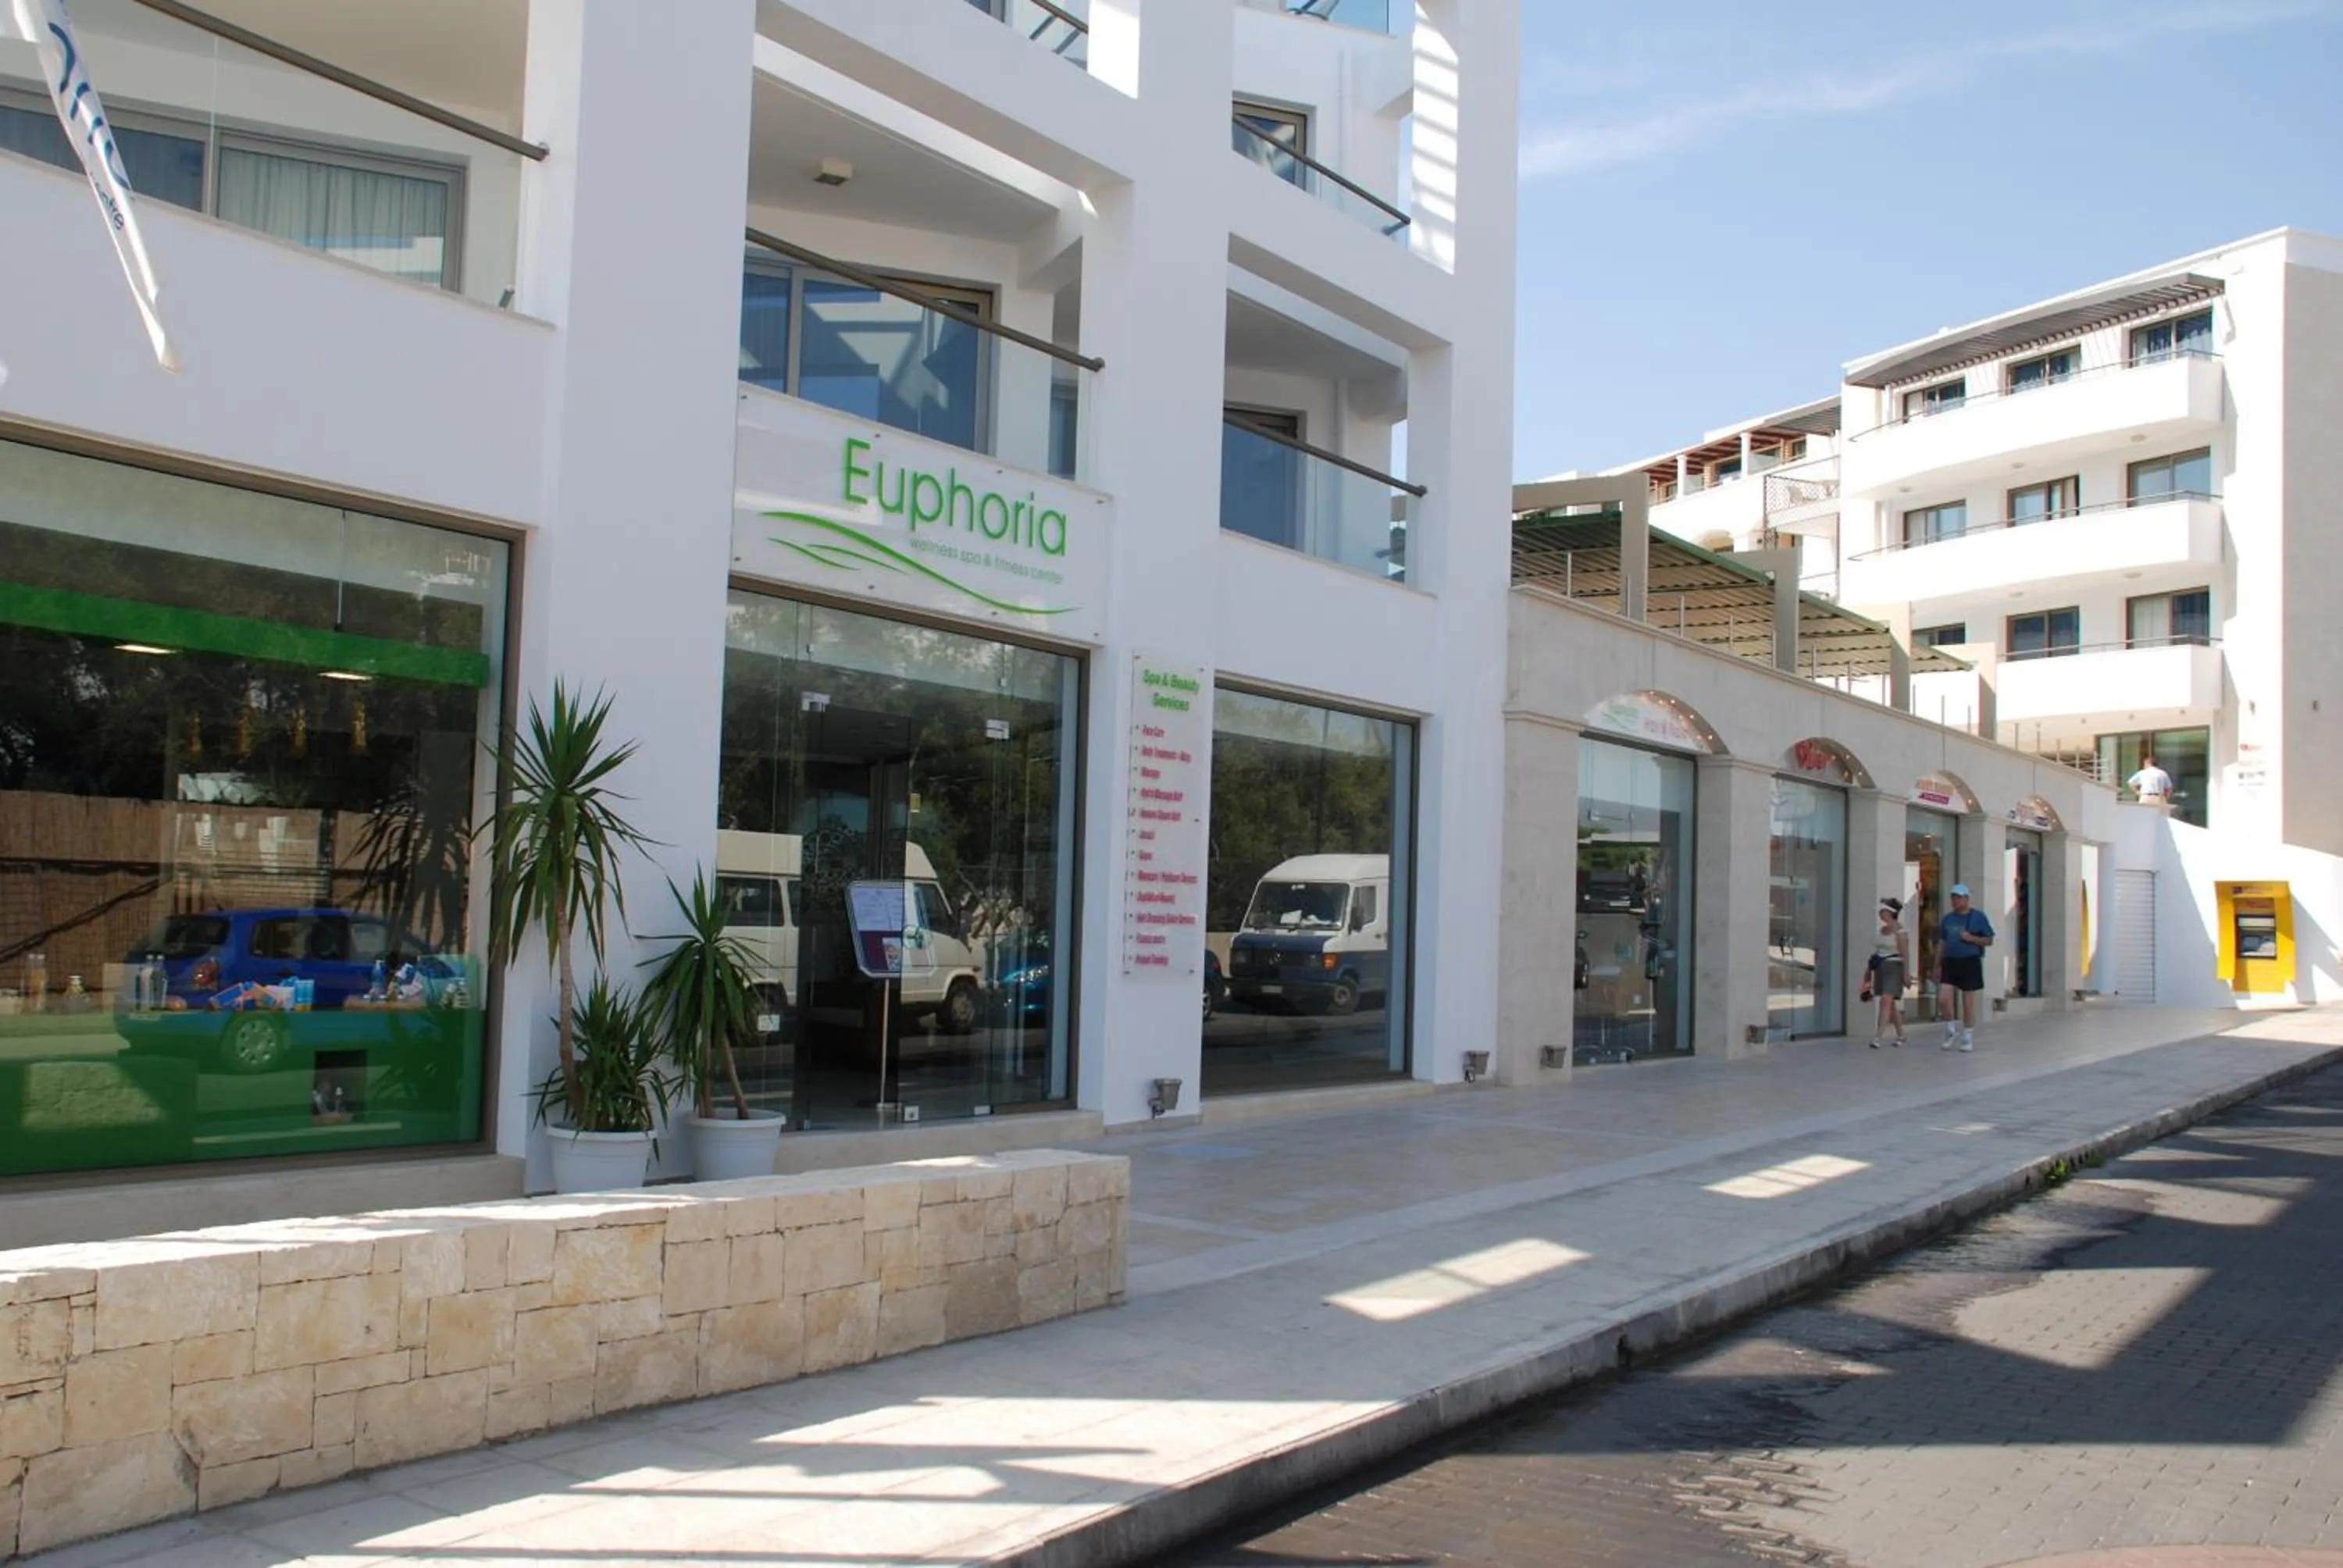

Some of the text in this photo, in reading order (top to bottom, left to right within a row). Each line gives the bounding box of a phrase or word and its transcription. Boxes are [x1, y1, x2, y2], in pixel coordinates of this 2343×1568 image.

[844, 437, 1067, 557] Euphoria
[909, 537, 958, 560] wellness
[960, 549, 981, 566] spa
[983, 553, 992, 568] &
[994, 553, 1029, 578] fitness
[1143, 668, 1200, 696] Spa & Beauty
[1153, 693, 1189, 711] Services
